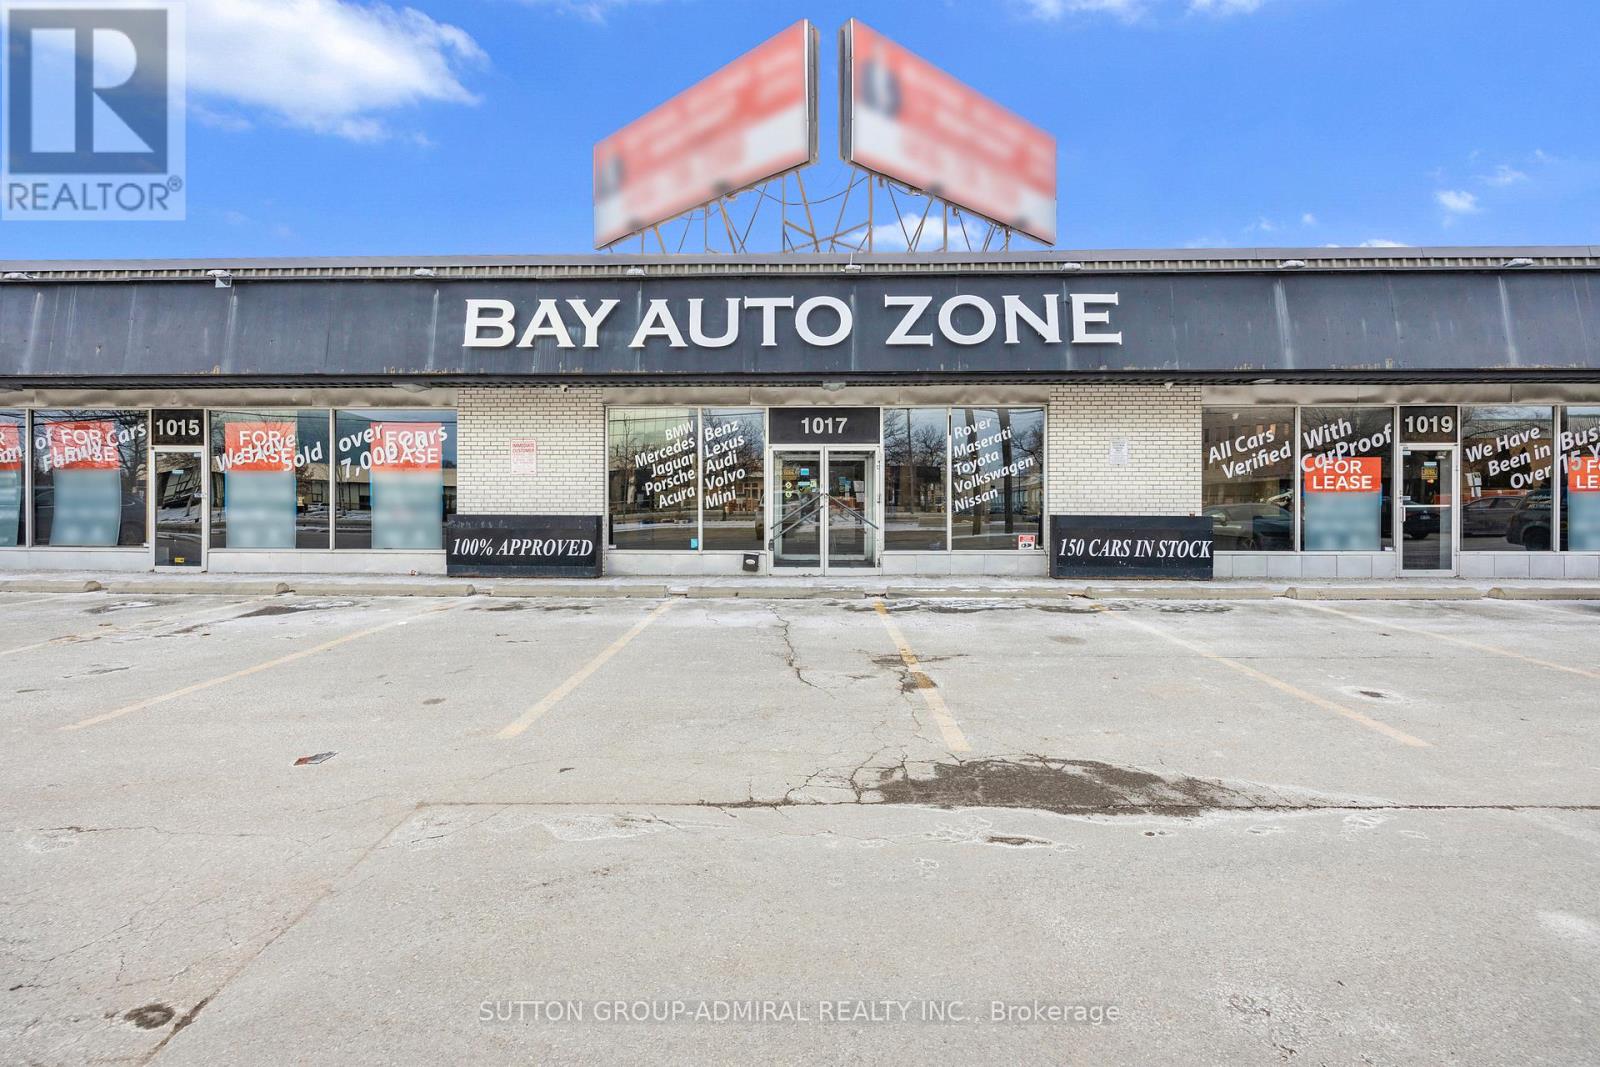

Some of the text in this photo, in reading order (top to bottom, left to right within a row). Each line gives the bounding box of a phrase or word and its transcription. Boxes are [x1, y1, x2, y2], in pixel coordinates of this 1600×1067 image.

[462, 292, 1122, 348] BAY AUTO ZONE
[35, 423, 147, 450] of Cars
[156, 419, 200, 436] 1015
[665, 420, 695, 441] BMW
[801, 417, 848, 434] 1017
[954, 417, 992, 439] Rover
[1303, 418, 1352, 449] With
[1405, 416, 1453, 433] 1019
[239, 430, 281, 447] FOR
[339, 424, 383, 452] over
[634, 420, 739, 468] Mercedes Benz
[705, 435, 745, 457] Lexus
[954, 426, 1012, 458] Maserati
[1208, 430, 1275, 464] All Cars
[1301, 423, 1392, 472] CarProof
[1465, 427, 1541, 463] We Have
[283, 441, 323, 472] Sold
[650, 453, 695, 478] Jaguar
[705, 450, 738, 474] Audi
[954, 451, 999, 475] Toyota
[1222, 441, 1291, 479] Verified
[1323, 460, 1362, 474] FOR
[1488, 444, 1551, 477] Been in
[1560, 449, 1582, 474] 15
[644, 469, 695, 496] Porsche
[705, 467, 745, 491] Volvo
[954, 456, 1034, 494] Volkswagen
[1312, 476, 1372, 489] LEASE
[1510, 466, 1552, 489] Over
[1576, 475, 1600, 489] LE
[659, 486, 695, 509] Acura
[705, 486, 736, 509] Mini
[954, 487, 998, 512] Nissan
[452, 538, 594, 557] 100% APPROVED
[1059, 538, 1213, 558] 150 CARS IN STOCK
